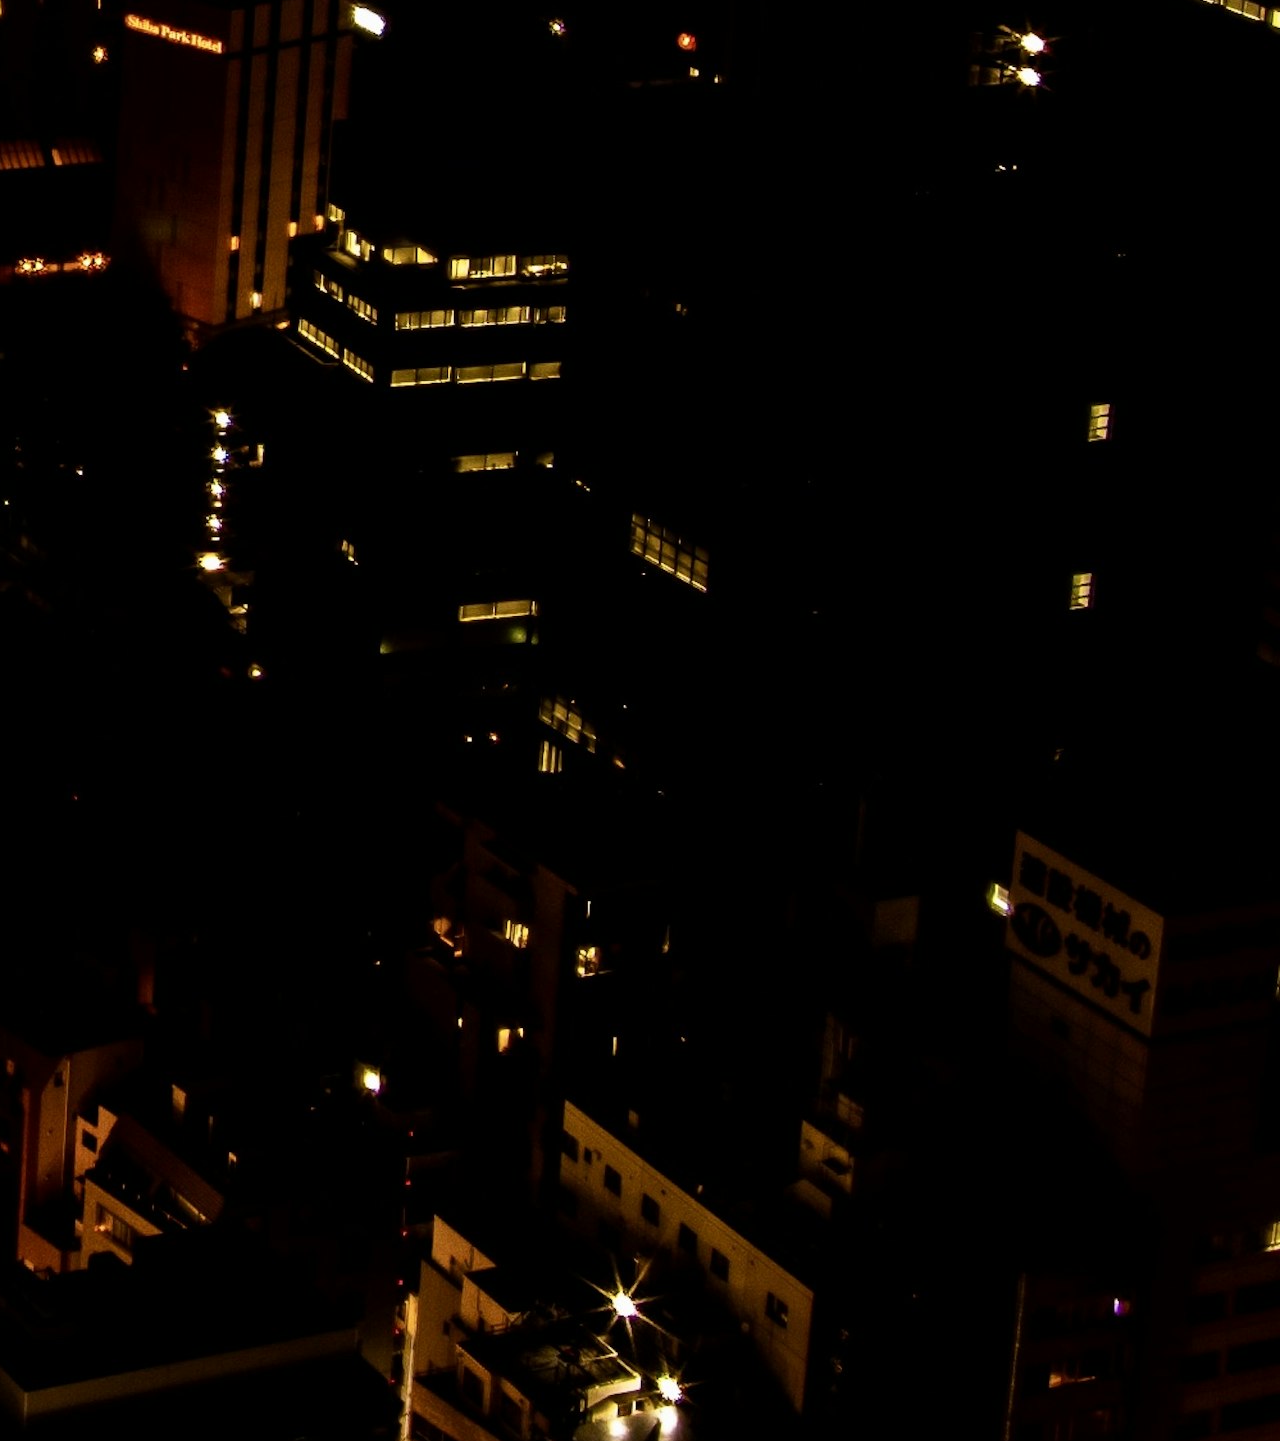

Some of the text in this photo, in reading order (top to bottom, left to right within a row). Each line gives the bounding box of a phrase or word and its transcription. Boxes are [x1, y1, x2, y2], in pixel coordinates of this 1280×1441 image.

[125, 14, 222, 54] Shiba Park Hotel
[1064, 932, 1151, 1014] サカイ
